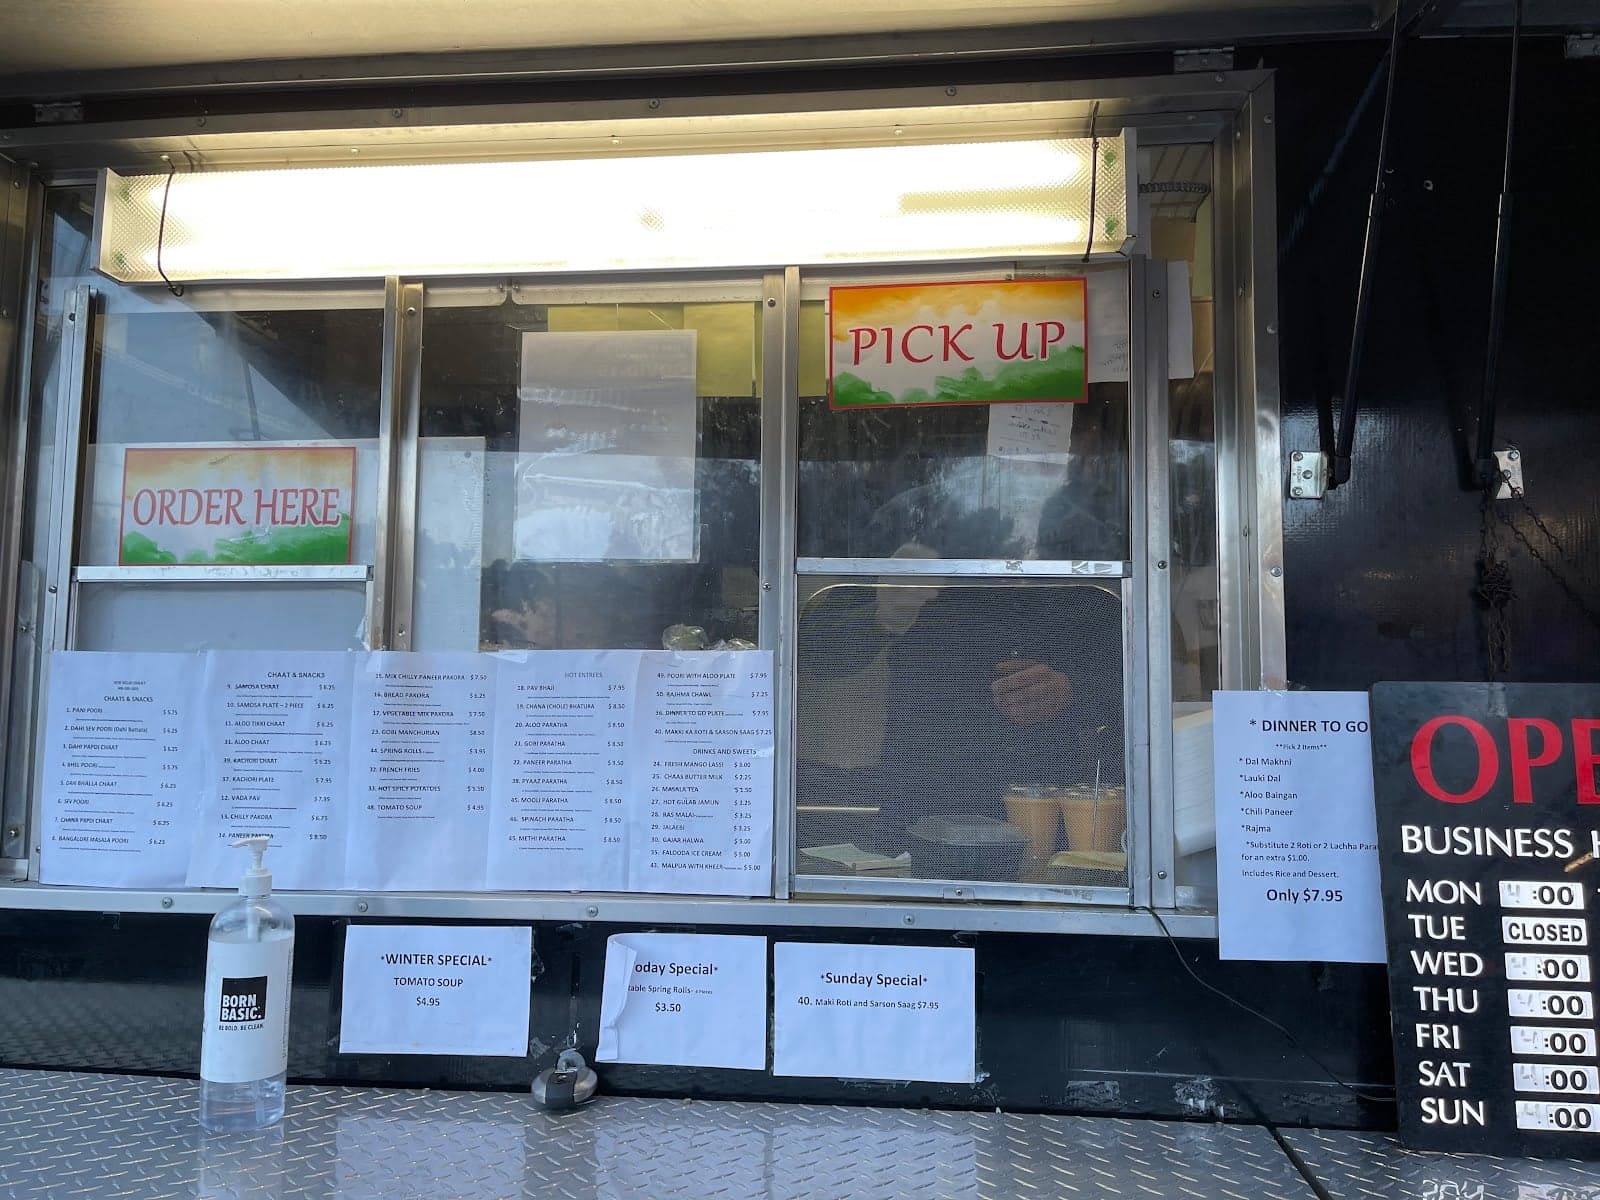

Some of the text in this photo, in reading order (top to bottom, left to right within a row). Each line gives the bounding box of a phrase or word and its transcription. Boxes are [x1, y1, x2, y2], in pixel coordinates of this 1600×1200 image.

[848, 323, 975, 366] PICK
[992, 321, 1066, 360] UP
[133, 488, 341, 526] ORDER HERE
[1262, 720, 1368, 733] DINNER TO GO
[1265, 791, 1298, 800] Baingan
[1401, 825, 1574, 858] BUSINESS
[1266, 888, 1343, 904] Only $7.95
[1406, 879, 1481, 905] MON
[1408, 914, 1582, 942] TUE CLOSED
[635, 962, 666, 976] oday
[1410, 950, 1484, 977] WED
[394, 977, 464, 987] TOMATO SOUP
[647, 985, 672, 994] Spring
[222, 994, 257, 1007] BORN
[416, 996, 440, 1007] $4.95
[655, 1002, 681, 1012] $3.50
[798, 997, 813, 1006] 40.
[870, 1000, 896, 1008] Sarson
[897, 1001, 916, 1010] Saag
[917, 1001, 939, 1010] $7.95
[1413, 986, 1480, 1013] THU
[221, 1007, 262, 1021] BASIC.
[1416, 1023, 1461, 1050] FRI
[1418, 1060, 1471, 1088] SAT
[1420, 1097, 1485, 1126] SUN
